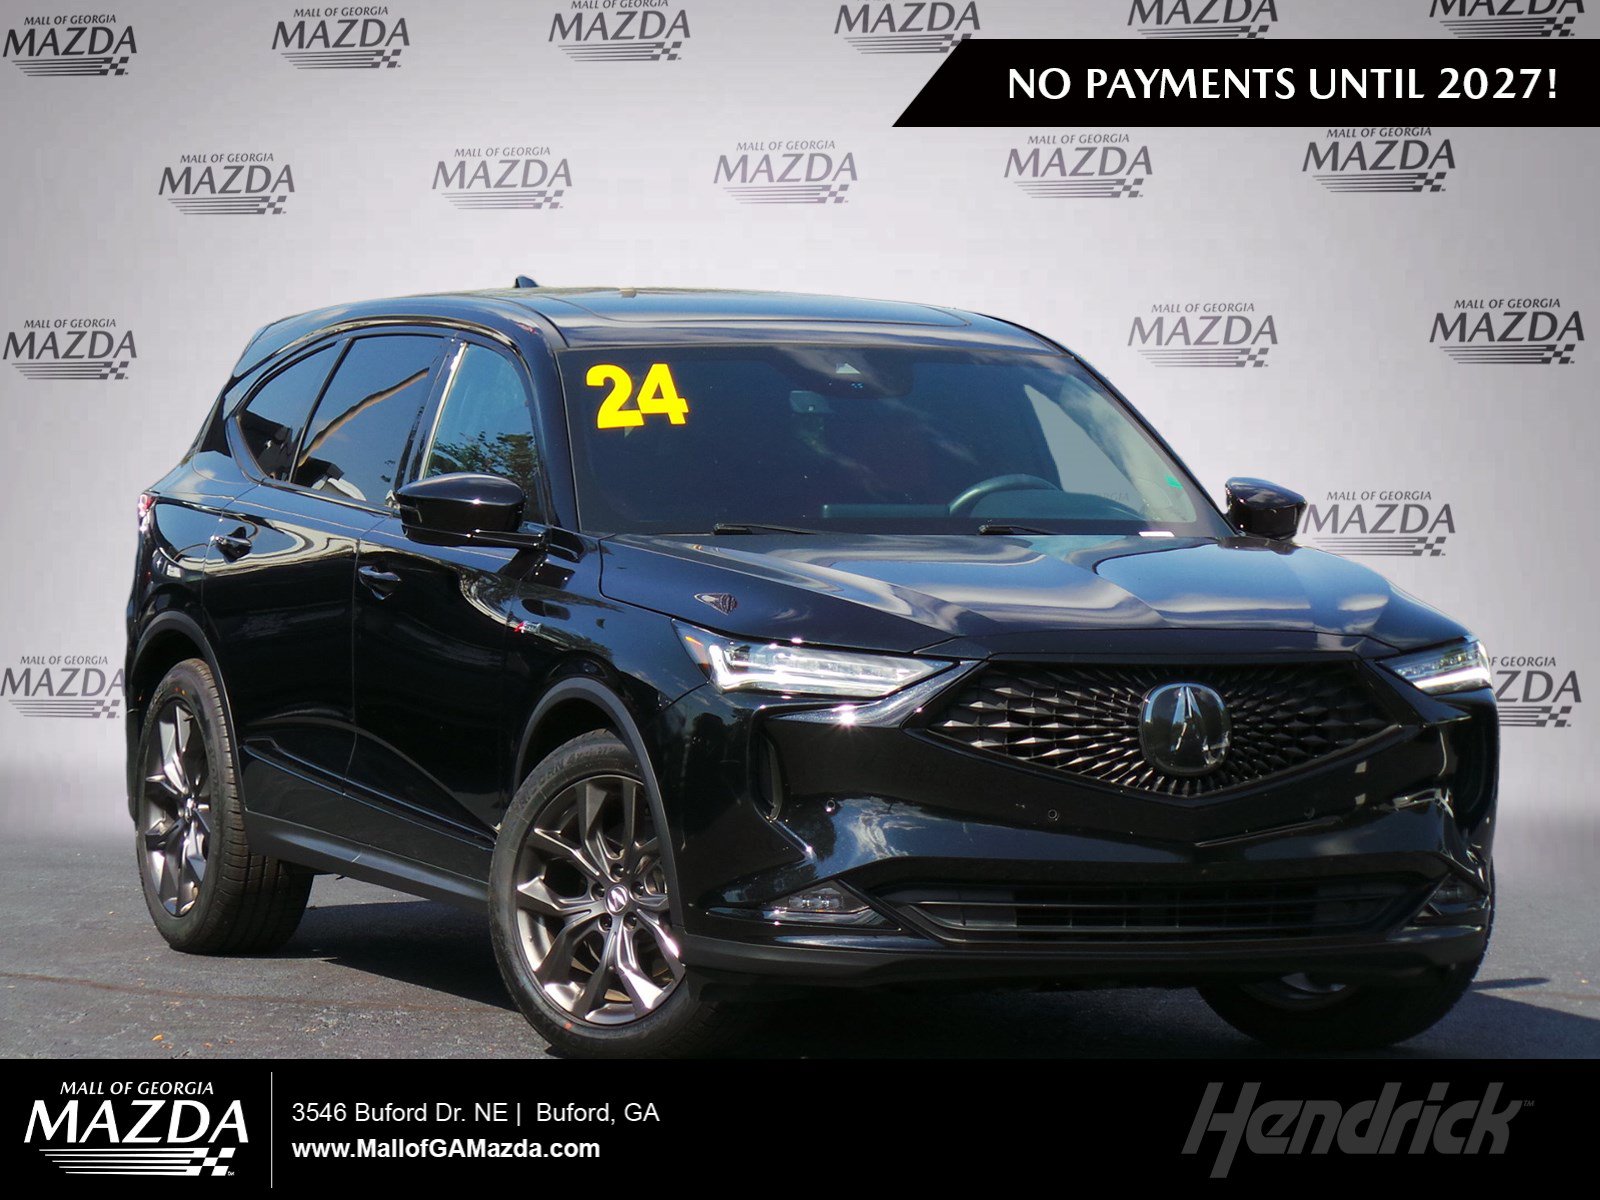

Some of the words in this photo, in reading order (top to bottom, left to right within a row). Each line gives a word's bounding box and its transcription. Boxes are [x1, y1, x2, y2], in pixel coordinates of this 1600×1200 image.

[293, 8, 321, 18] MALL
[324, 7, 339, 17] OF
[340, 5, 389, 17] GEORGIA
[571, 0, 599, 10] MALL
[602, 0, 617, 9] OF
[619, 0, 669, 9] GEORGIA
[834, 1, 980, 34] MAZDA
[1128, 0, 1278, 25] MAZDA
[23, 16, 51, 26] MALL
[53, 15, 68, 26] OF
[69, 14, 117, 25] GEORGIA
[272, 18, 409, 50] MAZDA
[549, 10, 690, 42] MAZDA
[3, 26, 138, 57] MAZDA
[736, 141, 765, 152] MALL
[768, 140, 784, 151] OF
[785, 139, 836, 151] GEORGIA
[1027, 135, 1056, 145] MALL
[1060, 134, 1076, 145] OF
[1078, 133, 1130, 144] GEORGIA
[1326, 128, 1357, 138] MALL
[1360, 127, 1377, 138] OF
[1378, 127, 1432, 138] GEORGIA
[180, 154, 207, 164] MALL
[210, 153, 225, 164] OF
[226, 152, 274, 163] GEORGIA
[454, 148, 482, 158] MALL
[485, 147, 500, 157] OF
[502, 146, 551, 157] GEORGIA
[1004, 146, 1152, 179] MAZDA
[1302, 139, 1456, 172] MAZDA
[158, 165, 294, 195] MAZDA
[432, 159, 572, 189] MAZDA
[714, 152, 857, 183] MAZDA
[1151, 303, 1181, 314] MALL
[1184, 303, 1201, 313] OF
[1202, 302, 1255, 313] GEORGIA
[1453, 299, 1485, 310] MALL
[1488, 298, 1505, 309] OF
[1507, 297, 1561, 309] GEORGIA
[23, 319, 51, 329] MALL
[53, 318, 68, 329] OF
[69, 318, 117, 329] GEORGIA
[1128, 315, 1278, 346] MAZDA
[1430, 311, 1584, 342] MAZDA
[3, 331, 137, 360] MAZDA
[586, 363, 689, 429] 24
[1326, 491, 1357, 501] MALL
[1360, 490, 1377, 501] OF
[1379, 490, 1432, 501] GEORGIA
[1303, 503, 1456, 534] MAZDA
[19, 655, 46, 665] MALL
[48, 655, 62, 666] OF
[63, 655, 108, 666] GEORGIA
[1499, 655, 1558, 668] GEORGIA
[0, 668, 125, 697] MAZDA
[1496, 670, 1582, 703] ZDA
